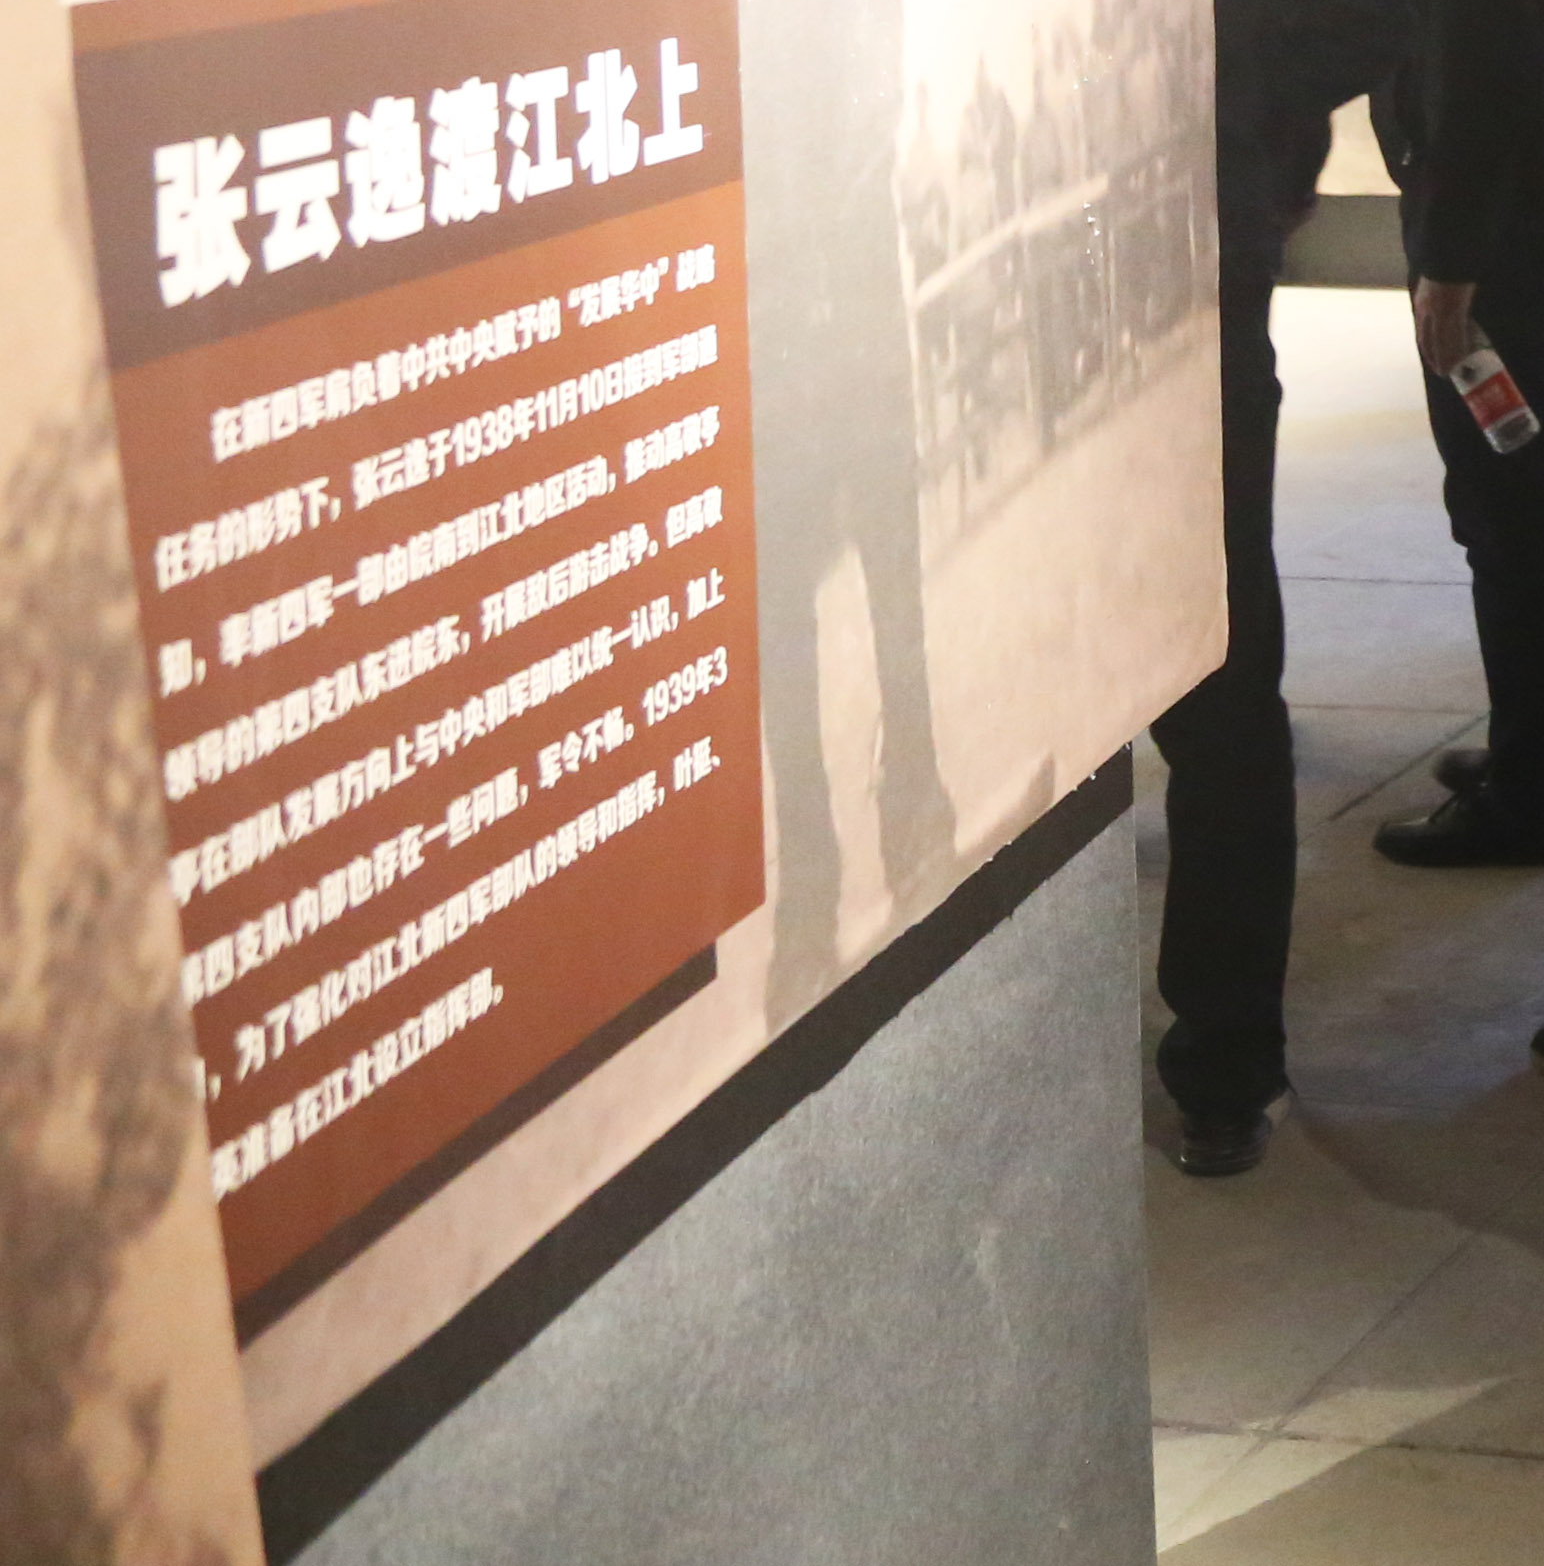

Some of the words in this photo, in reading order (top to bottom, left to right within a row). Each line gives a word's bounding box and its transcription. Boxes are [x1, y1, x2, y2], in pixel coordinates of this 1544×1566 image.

[154, 37, 702, 305] 张云逸渡江北上
[155, 324, 717, 588] 任务的形势下，张云逸于1938年11月10日接到军部通
[160, 405, 719, 694] 知，率新四军一部由皖南到江北地区活动，推动高敬亭
[165, 485, 722, 798] 领导的第四支队东进皖东，开展敌后游击战争。但高敬
